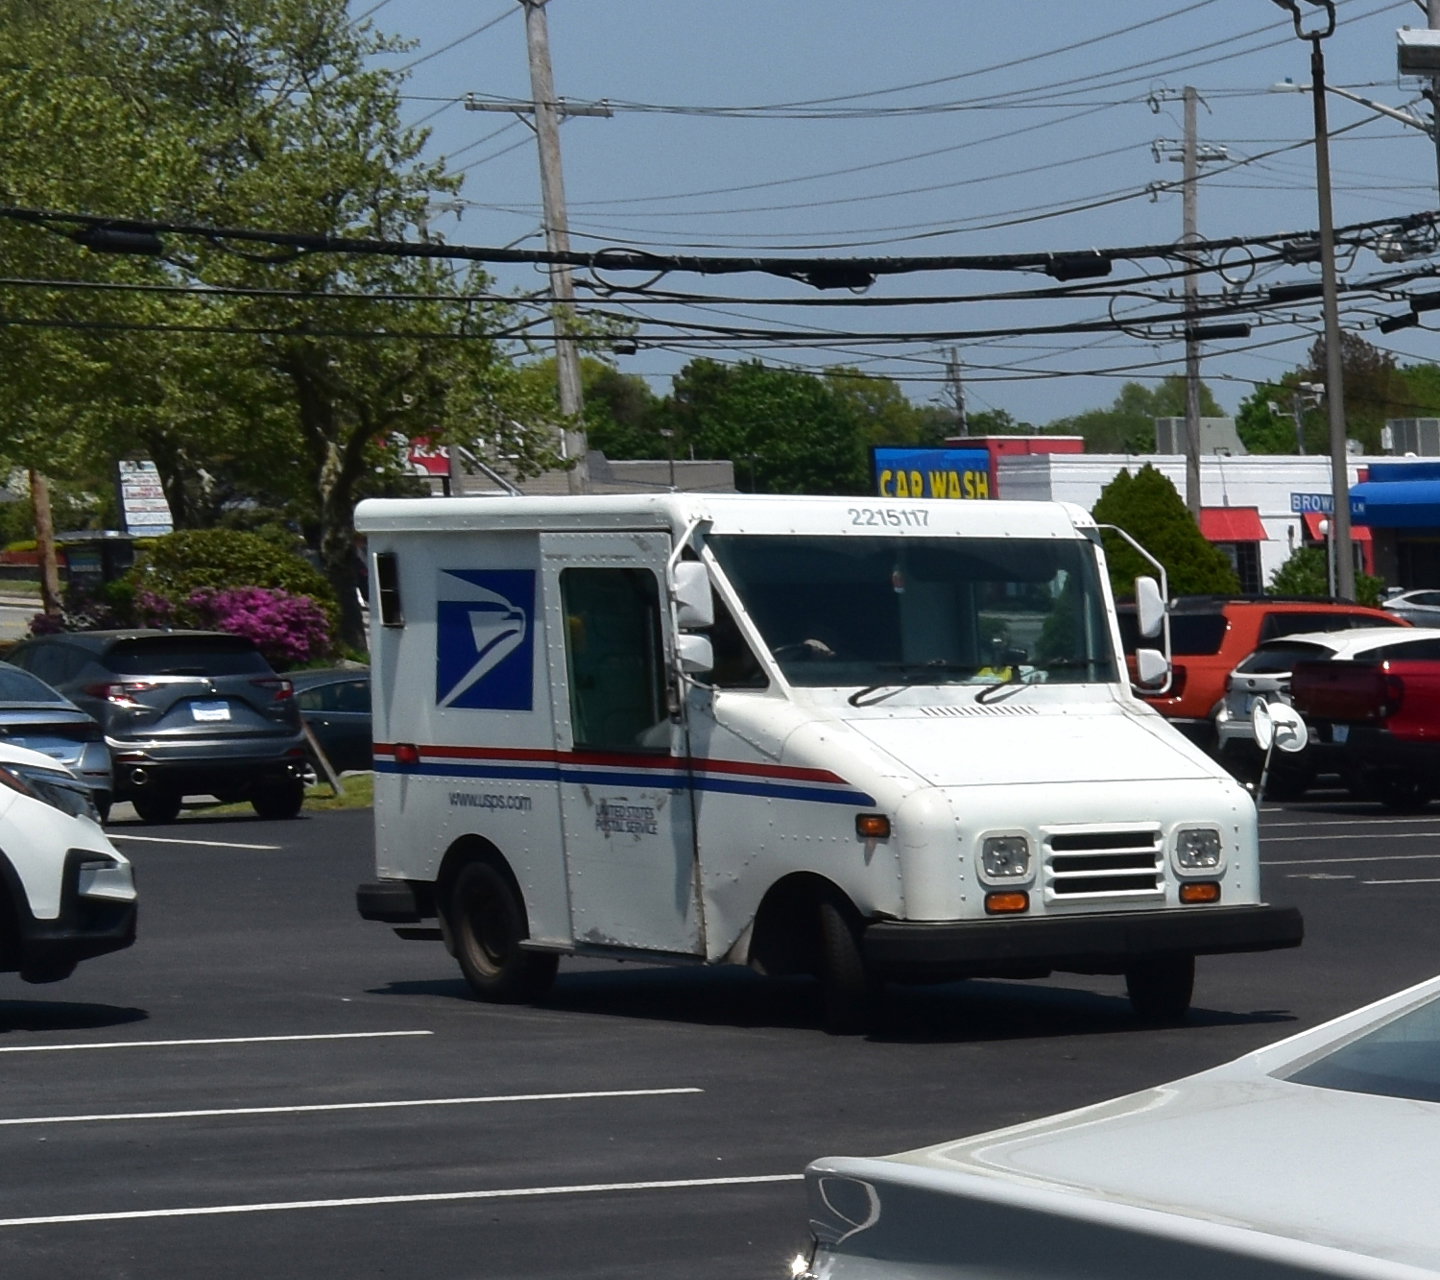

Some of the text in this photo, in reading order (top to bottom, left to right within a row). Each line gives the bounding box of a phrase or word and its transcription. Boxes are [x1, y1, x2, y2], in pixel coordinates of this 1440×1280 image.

[879, 469, 989, 499] CAR WASH
[1293, 495, 1334, 511] BROW
[848, 508, 929, 527] 2215117
[449, 792, 532, 813] www.usps.com
[596, 804, 655, 820] UNITED STATES
[595, 819, 658, 835] POSTAL SERVICE
